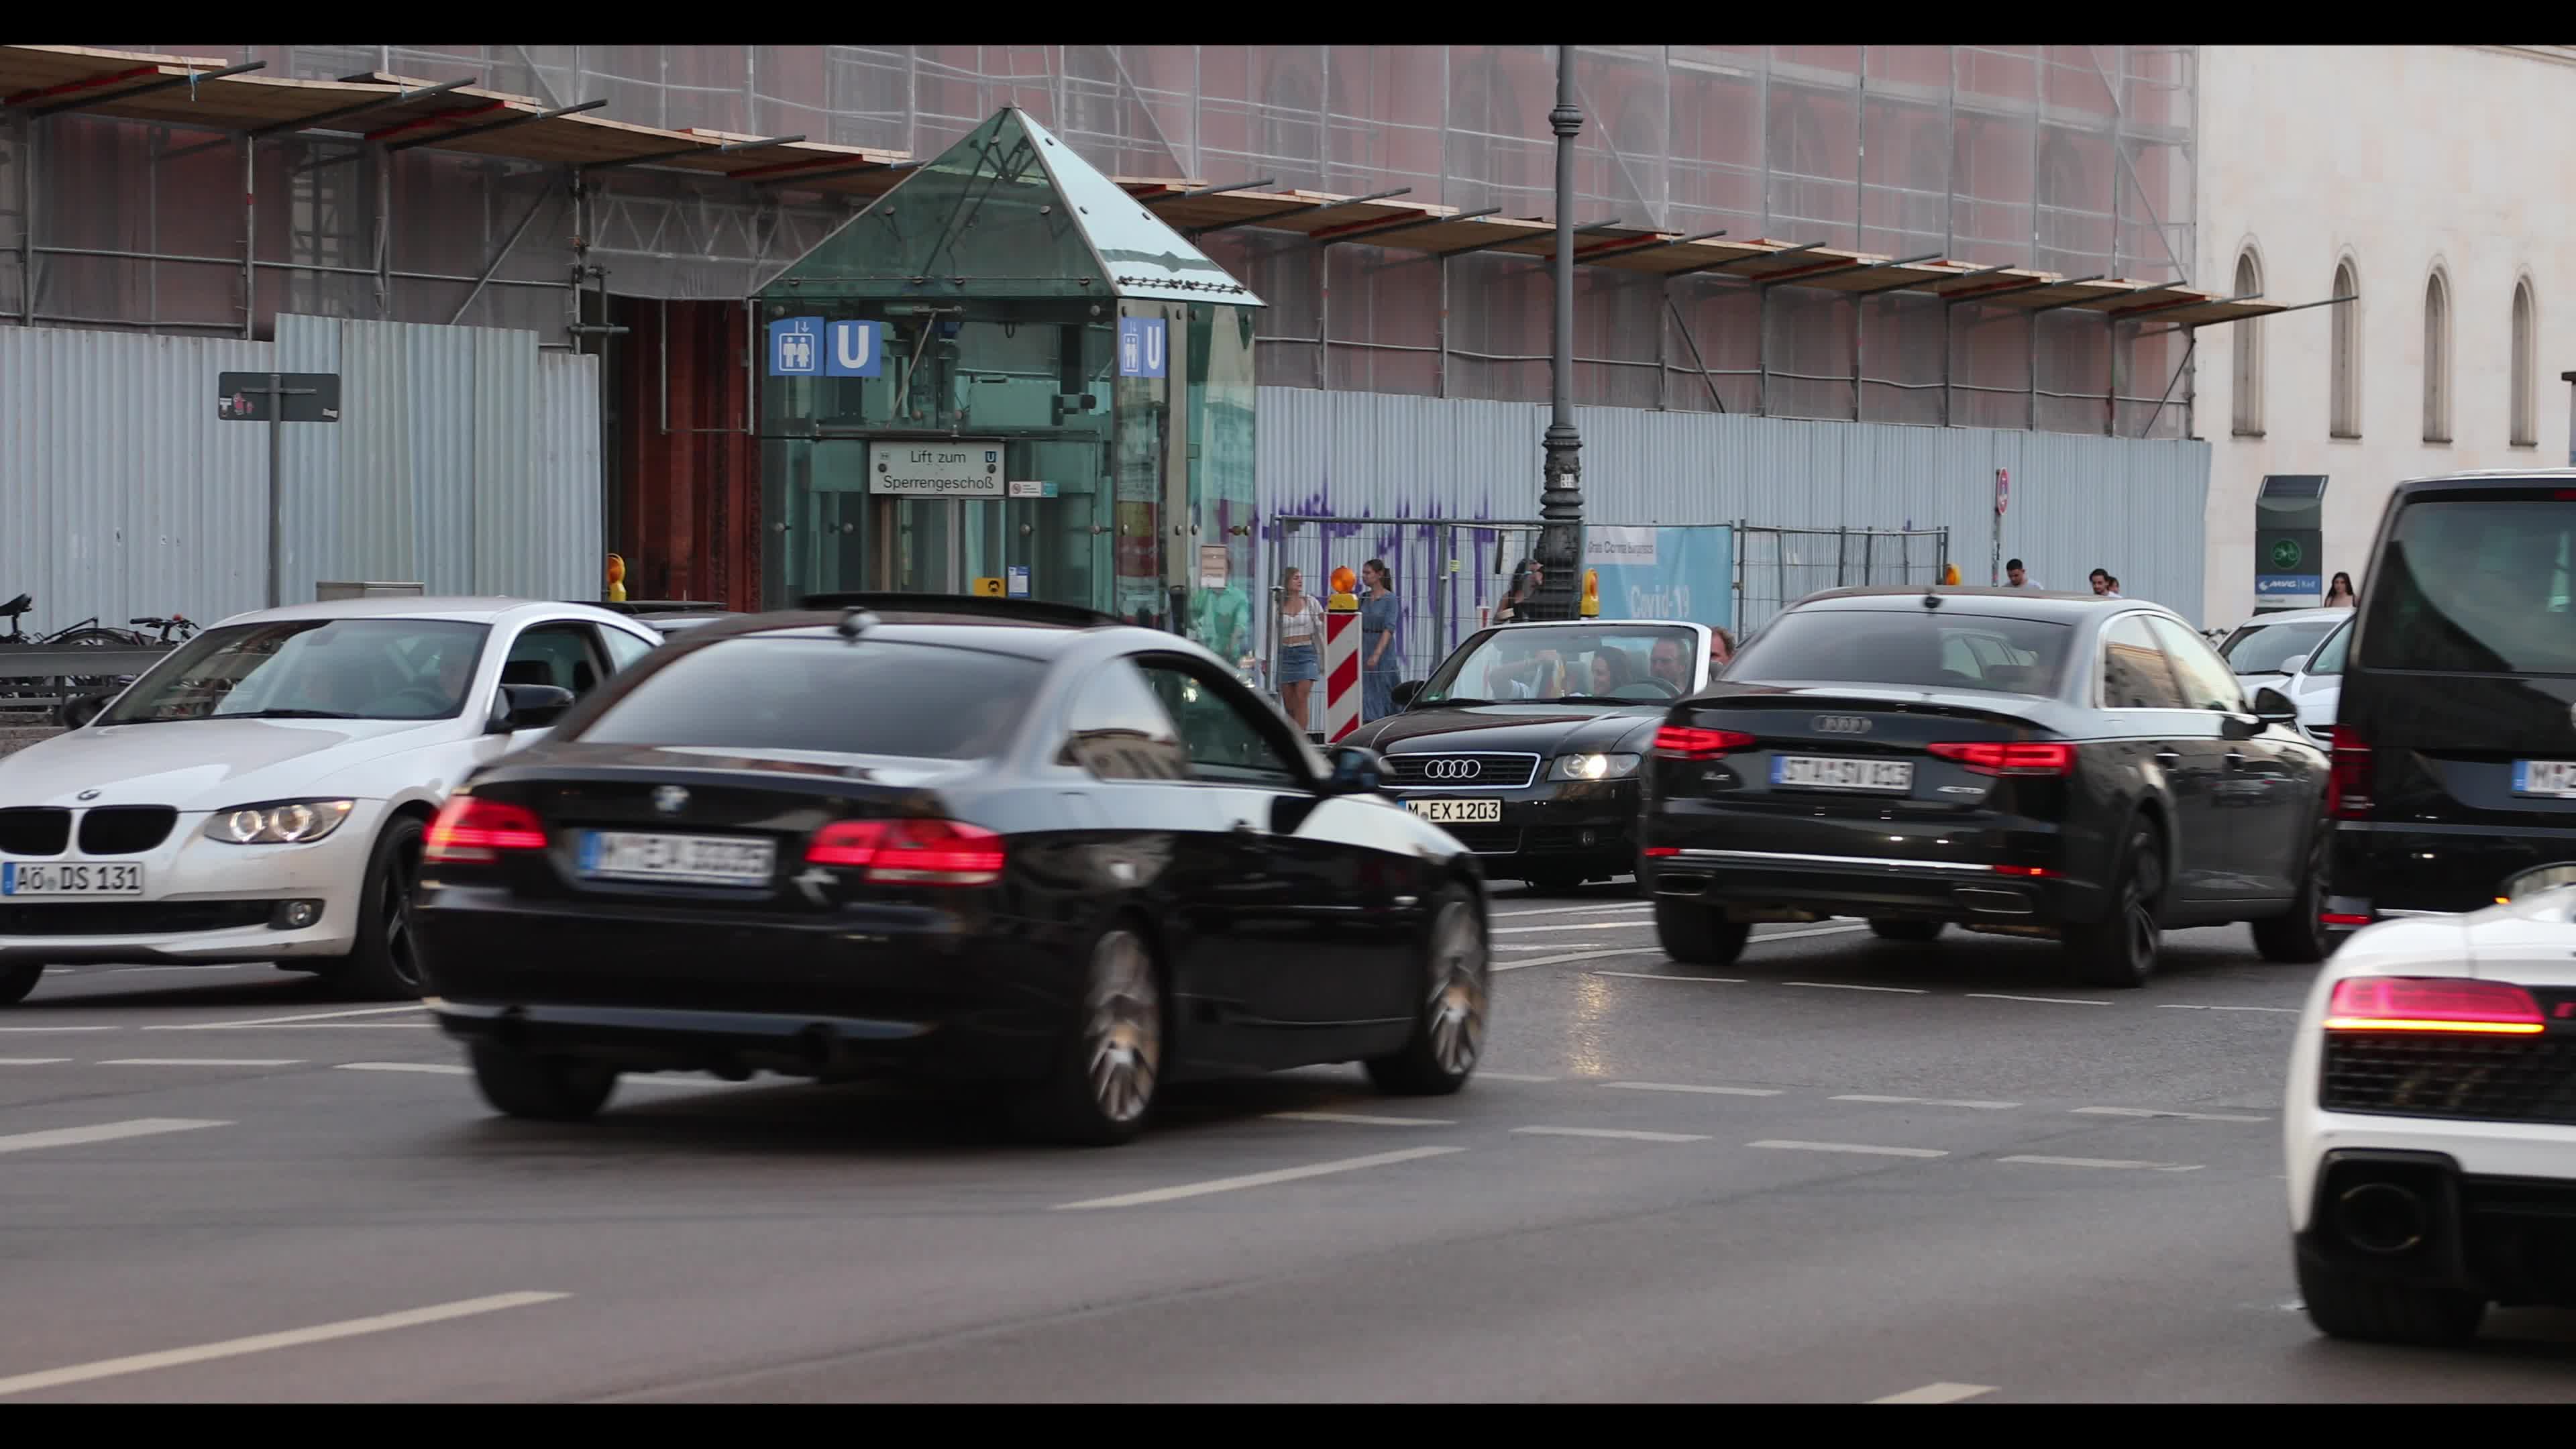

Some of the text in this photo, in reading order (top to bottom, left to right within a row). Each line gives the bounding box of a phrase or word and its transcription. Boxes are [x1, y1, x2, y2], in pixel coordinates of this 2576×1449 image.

[839, 325, 869, 368] U
[1148, 326, 1161, 370] U
[911, 451, 966, 463] Lift zum
[883, 476, 994, 491] Sperrengeschoß
[1631, 584, 1690, 619] Covid-19
[1430, 803, 1452, 819] EX
[1456, 803, 1498, 819] 1203
[17, 867, 140, 890] AÖ DS 131
